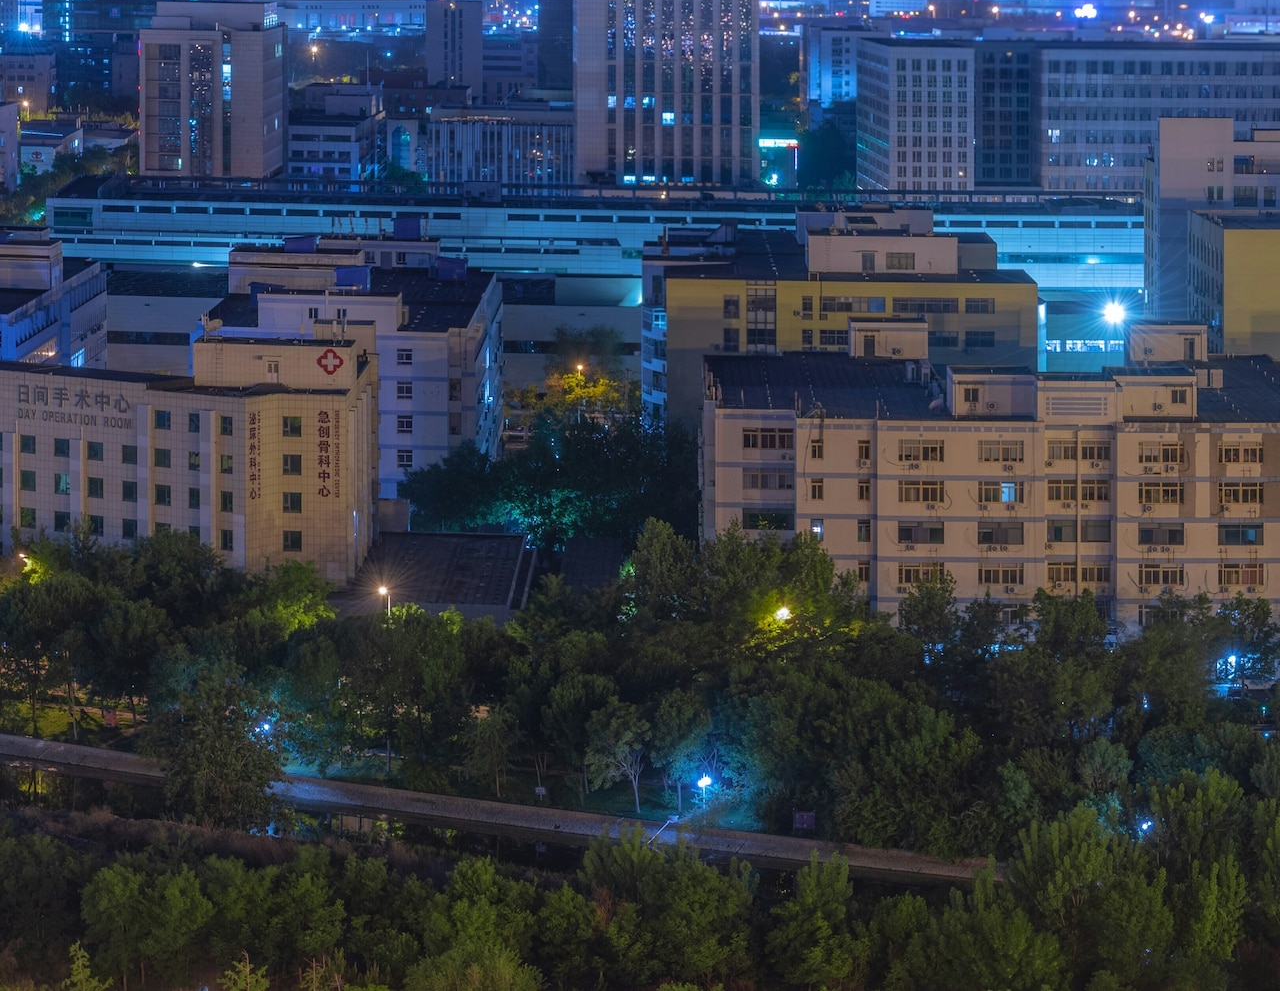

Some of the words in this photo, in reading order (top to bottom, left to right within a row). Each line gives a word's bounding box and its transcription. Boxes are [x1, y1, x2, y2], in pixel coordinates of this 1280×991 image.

[18, 384, 131, 413] 日间手术中心
[18, 408, 37, 420] DAY
[42, 411, 97, 427] OPERATION
[104, 416, 132, 430] ROOM
[317, 410, 331, 498] 急创骨科中心
